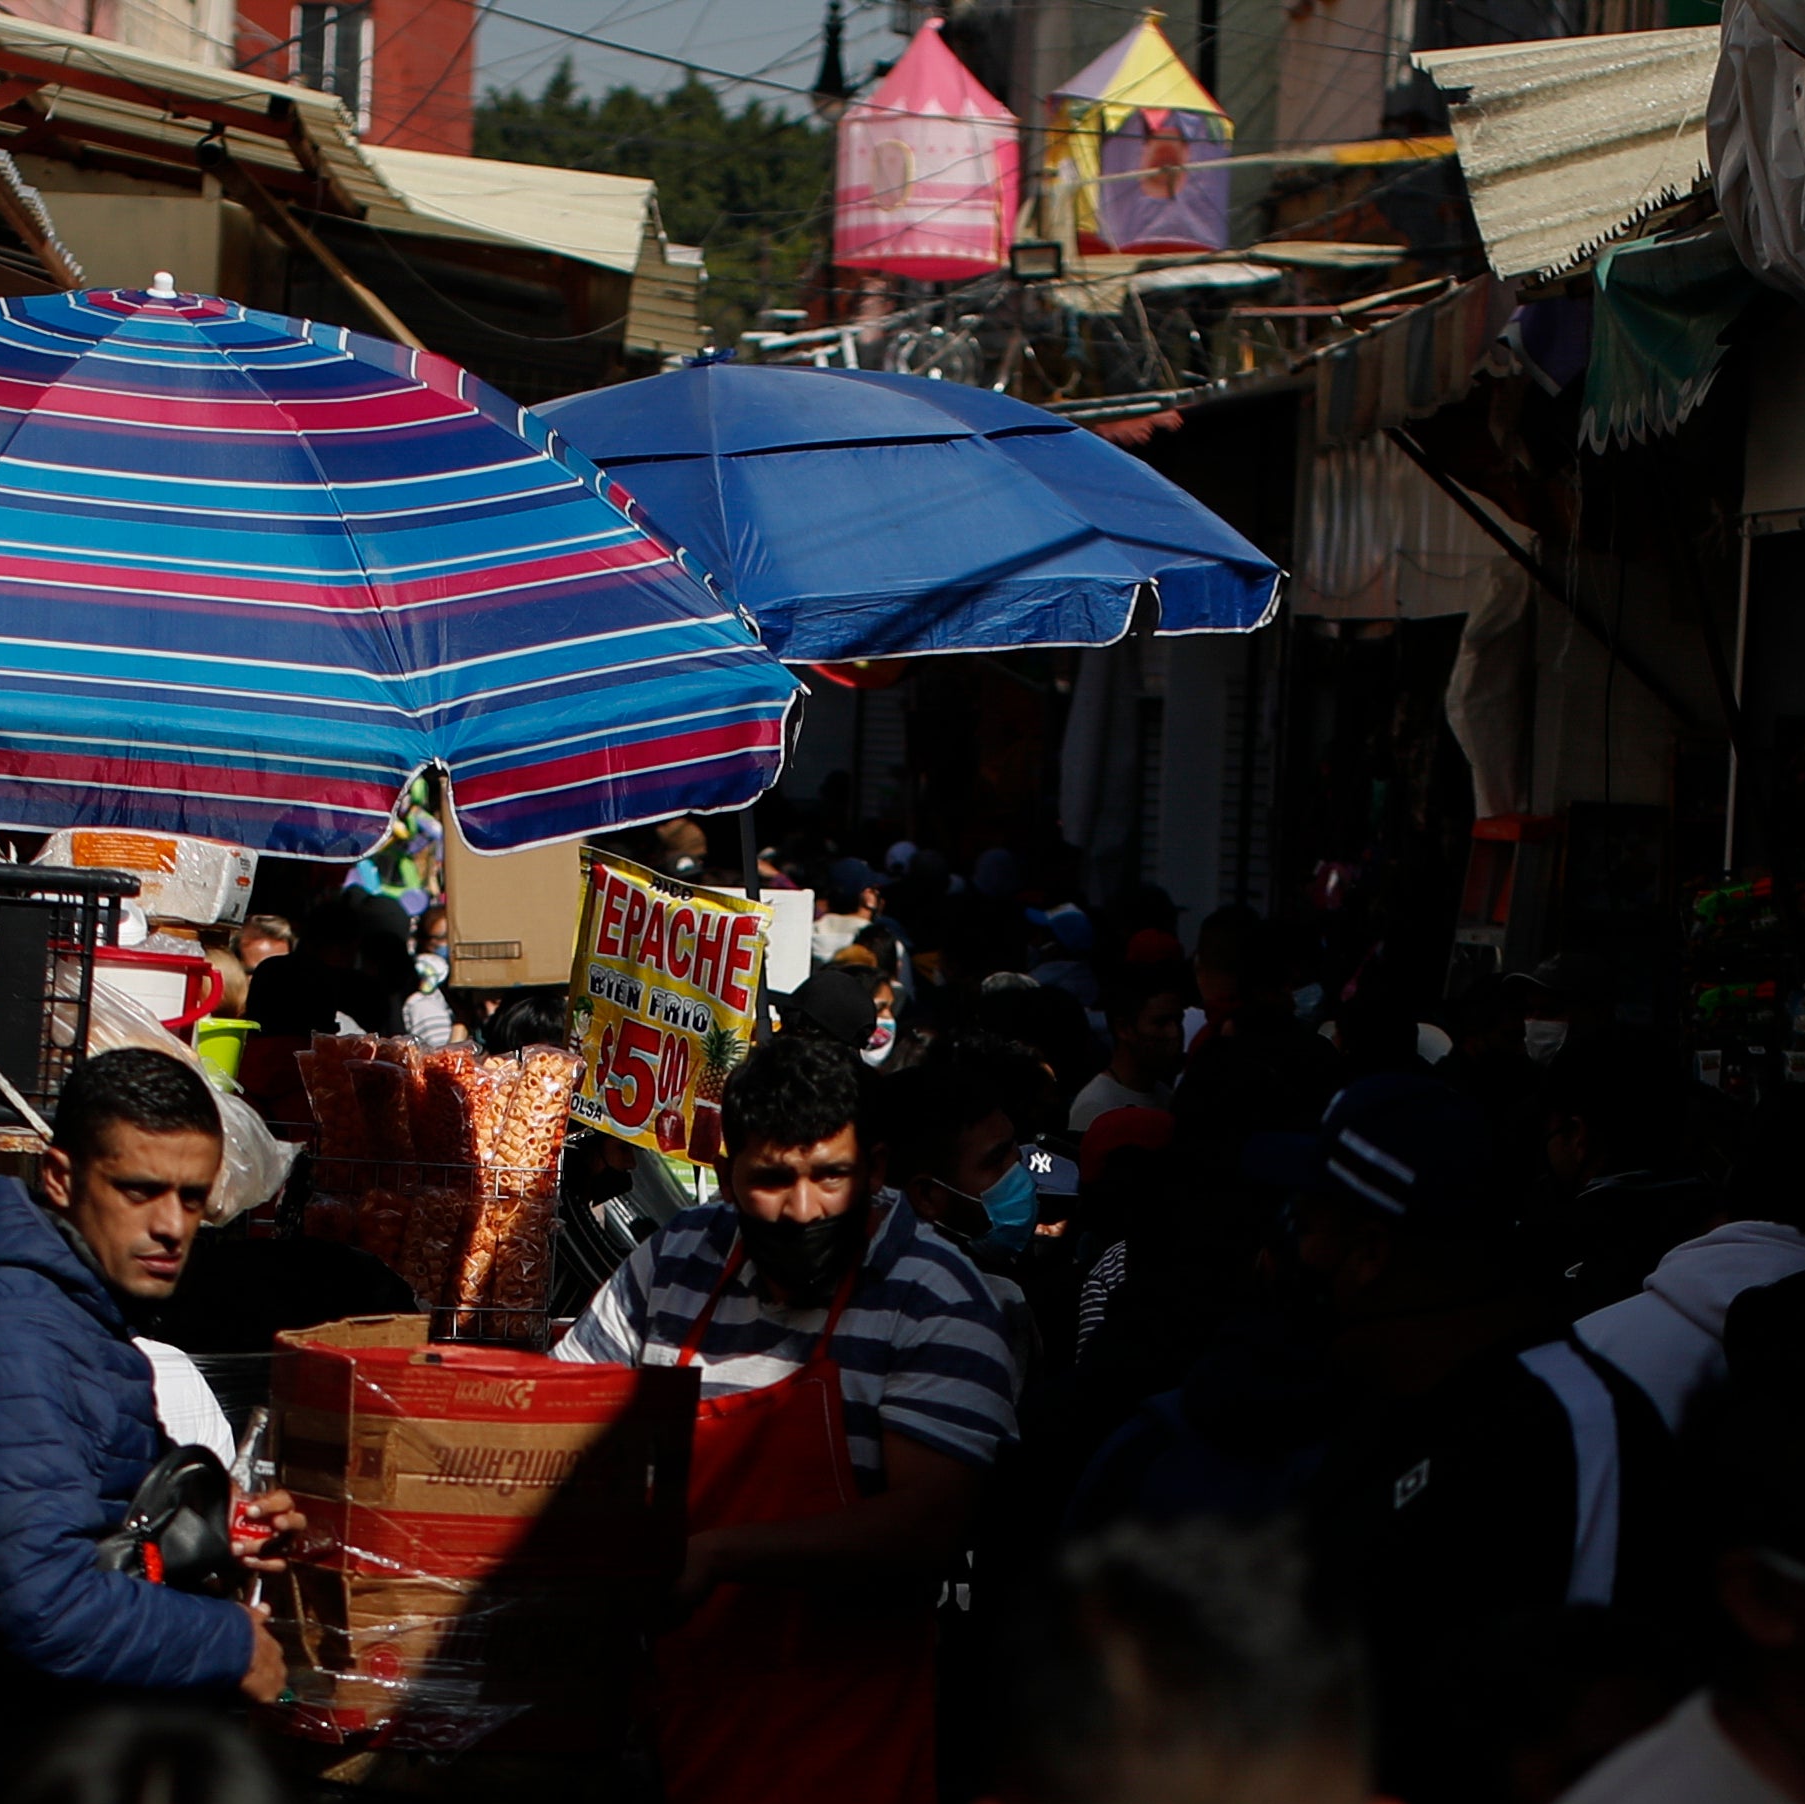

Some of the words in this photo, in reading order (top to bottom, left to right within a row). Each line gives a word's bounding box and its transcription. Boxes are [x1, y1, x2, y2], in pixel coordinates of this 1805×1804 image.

[588, 964, 644, 1011] BIEN
[648, 986, 713, 1034] FRIO
[570, 1094, 603, 1122] OLSA
[1028, 1151, 1053, 1174] NY
